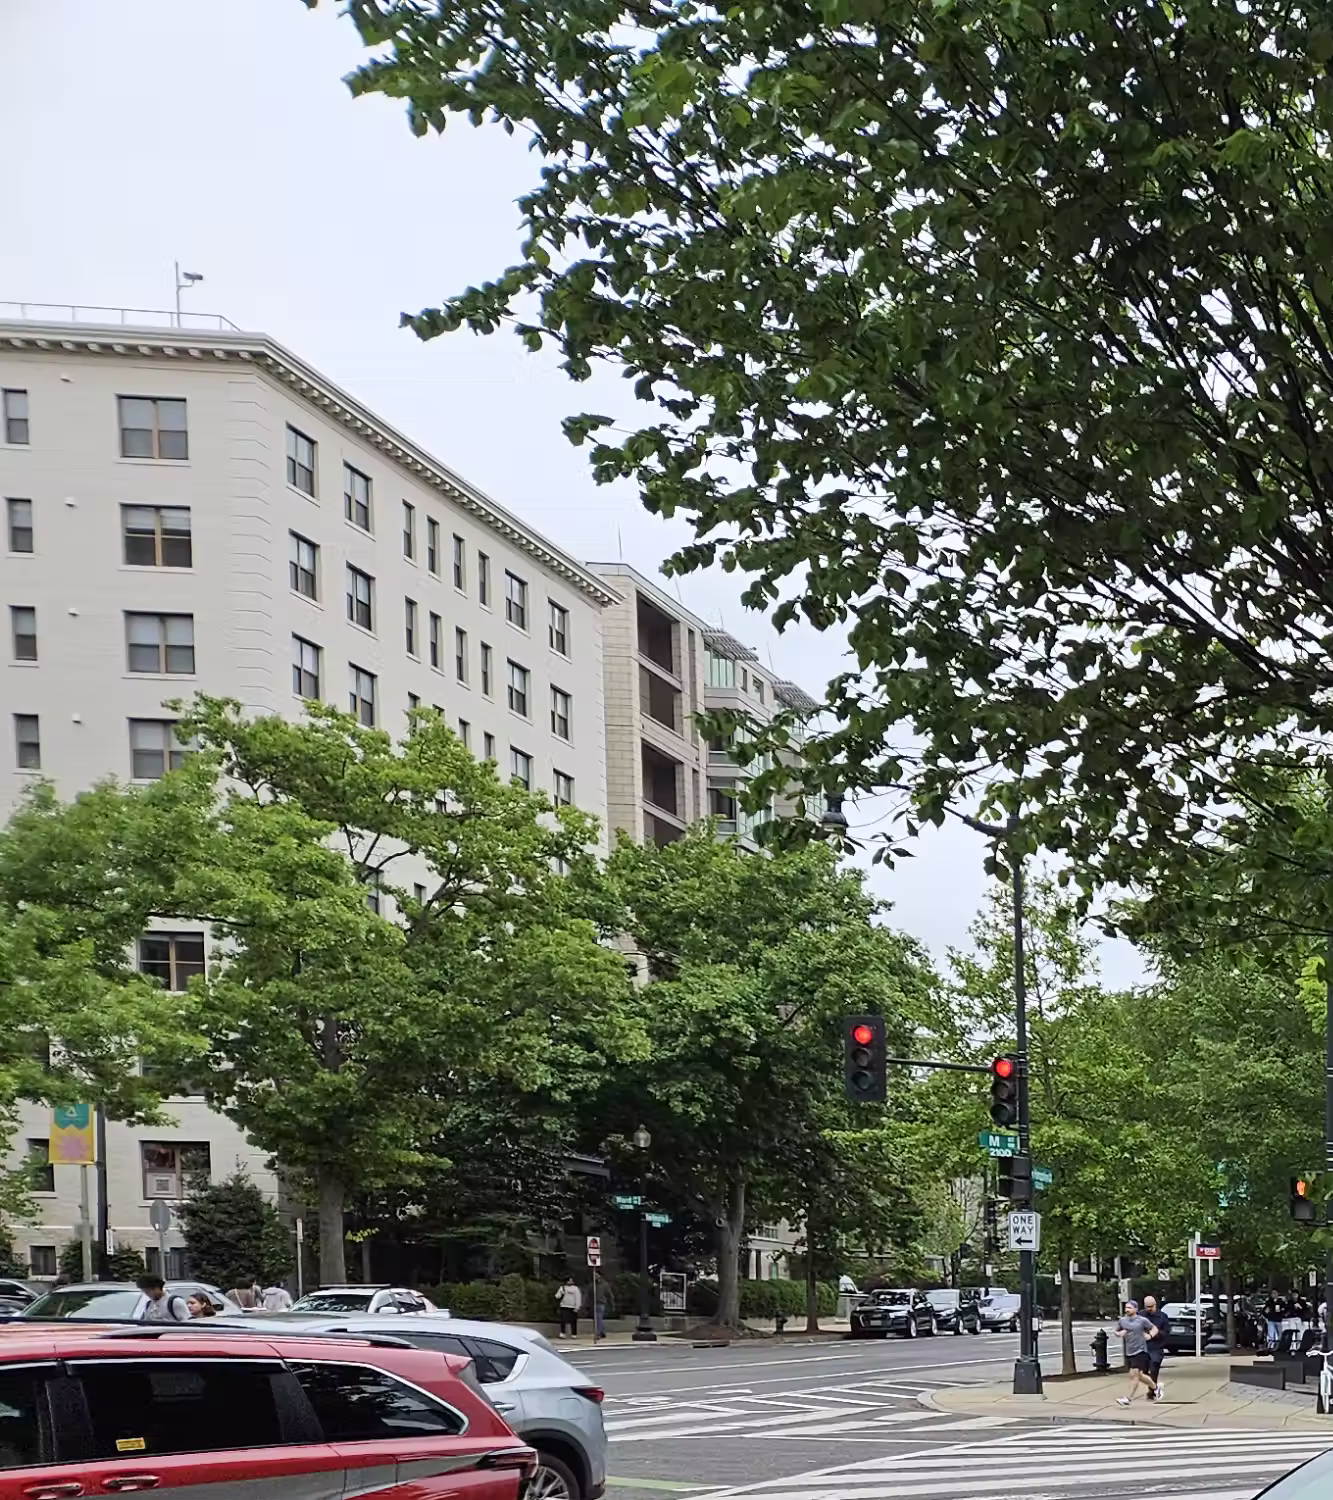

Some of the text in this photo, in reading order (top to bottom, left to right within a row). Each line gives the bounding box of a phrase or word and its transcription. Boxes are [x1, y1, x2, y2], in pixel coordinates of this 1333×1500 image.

[989, 1135, 1000, 1147] M
[1013, 1216, 1033, 1224] ONE
[1013, 1226, 1033, 1234] WAY
